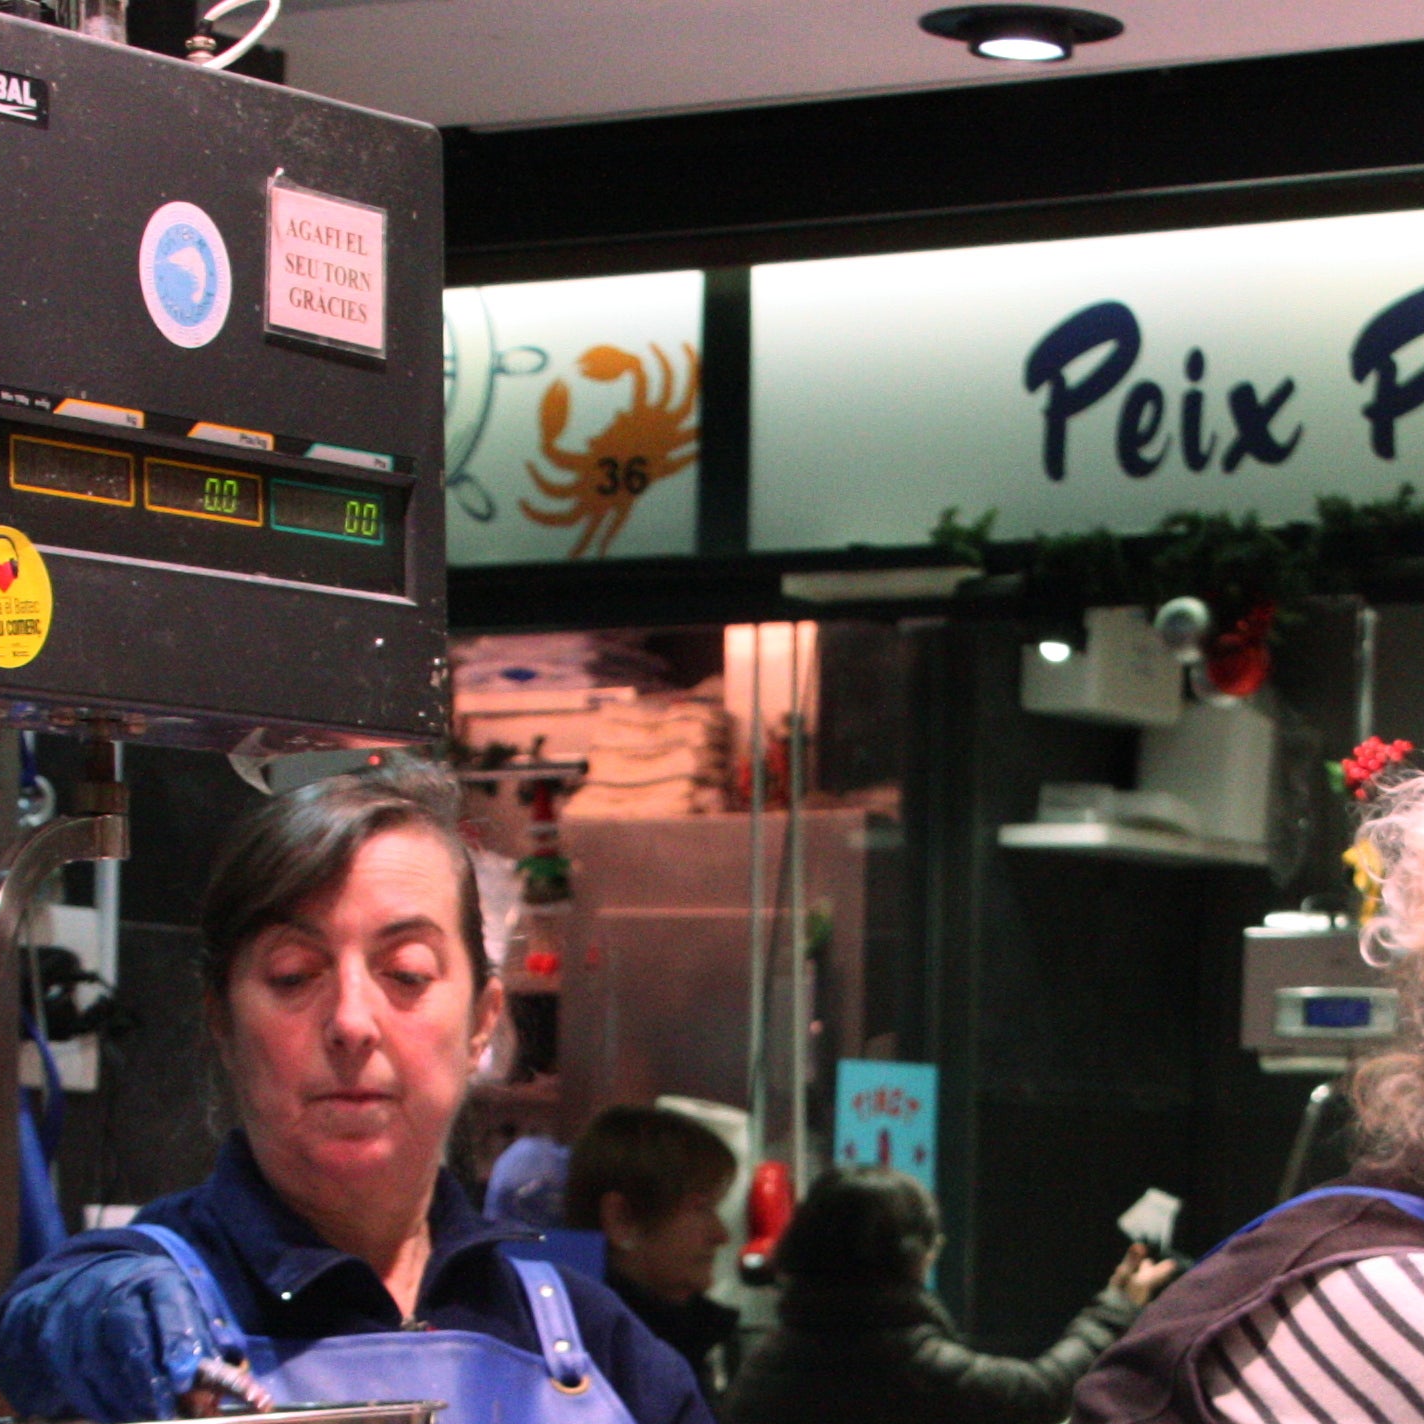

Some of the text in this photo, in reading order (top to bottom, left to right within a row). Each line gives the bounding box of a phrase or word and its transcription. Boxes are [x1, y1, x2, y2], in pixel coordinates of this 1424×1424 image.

[286, 218, 367, 256] AGAFI EL
[285, 253, 372, 292] SEU TORN
[289, 286, 367, 323] GRÀCIES
[1024, 300, 1303, 482] Peix
[596, 455, 650, 497] 36
